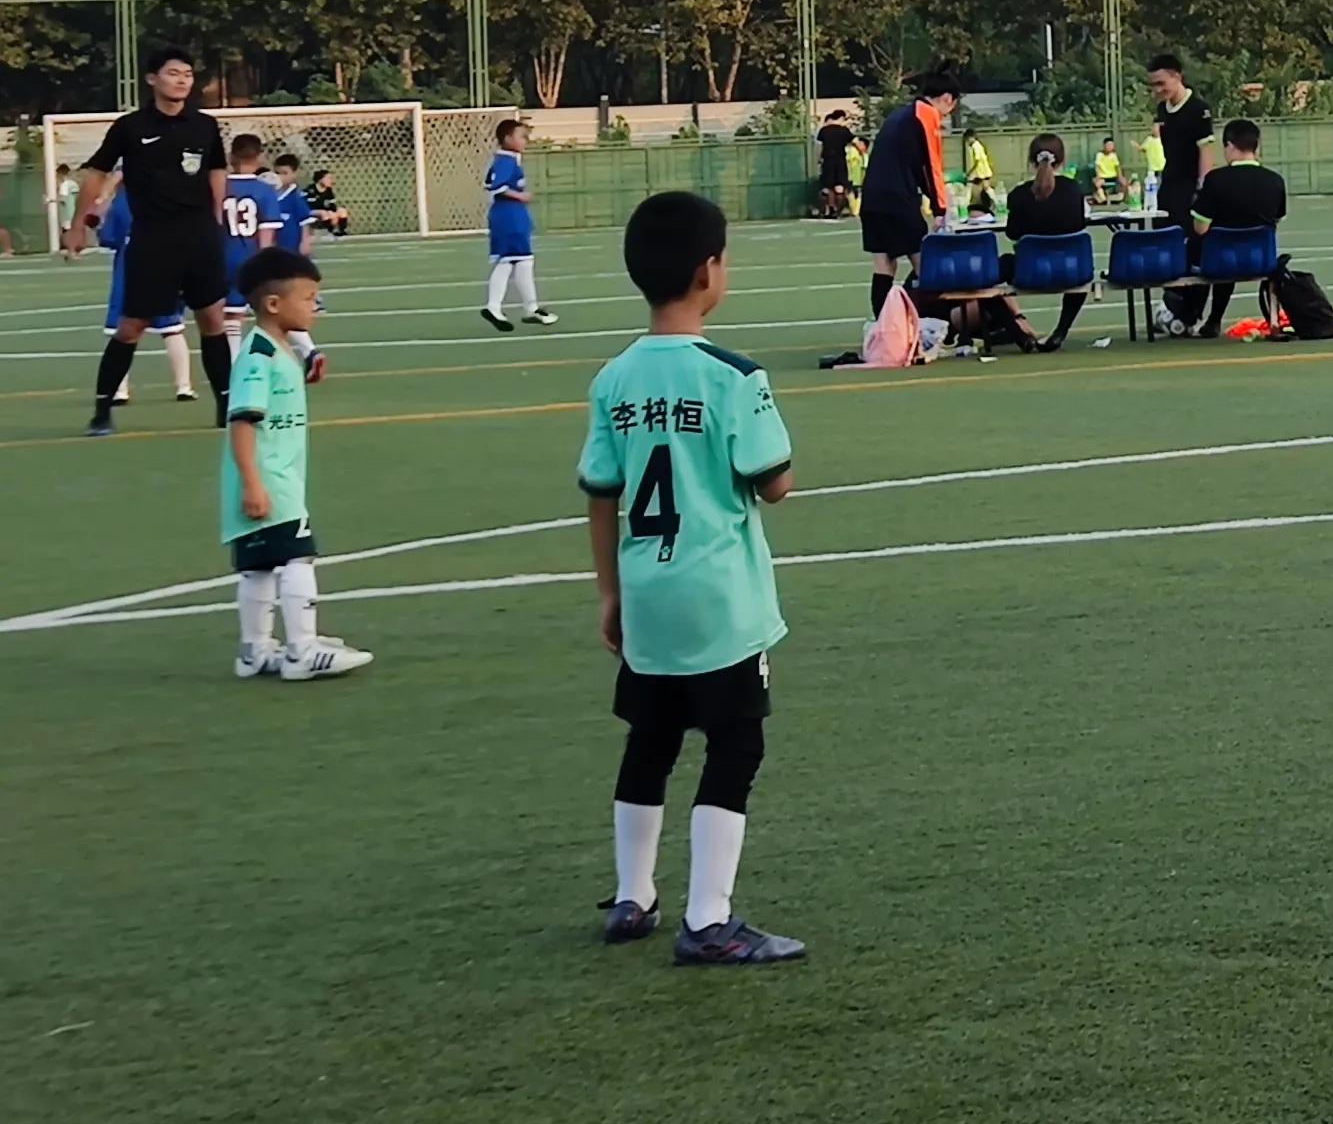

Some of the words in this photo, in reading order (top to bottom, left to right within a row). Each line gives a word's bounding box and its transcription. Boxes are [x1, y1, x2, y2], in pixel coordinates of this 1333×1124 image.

[223, 197, 258, 237] 13
[611, 397, 704, 436] 李梓恒
[628, 444, 681, 563] 4
